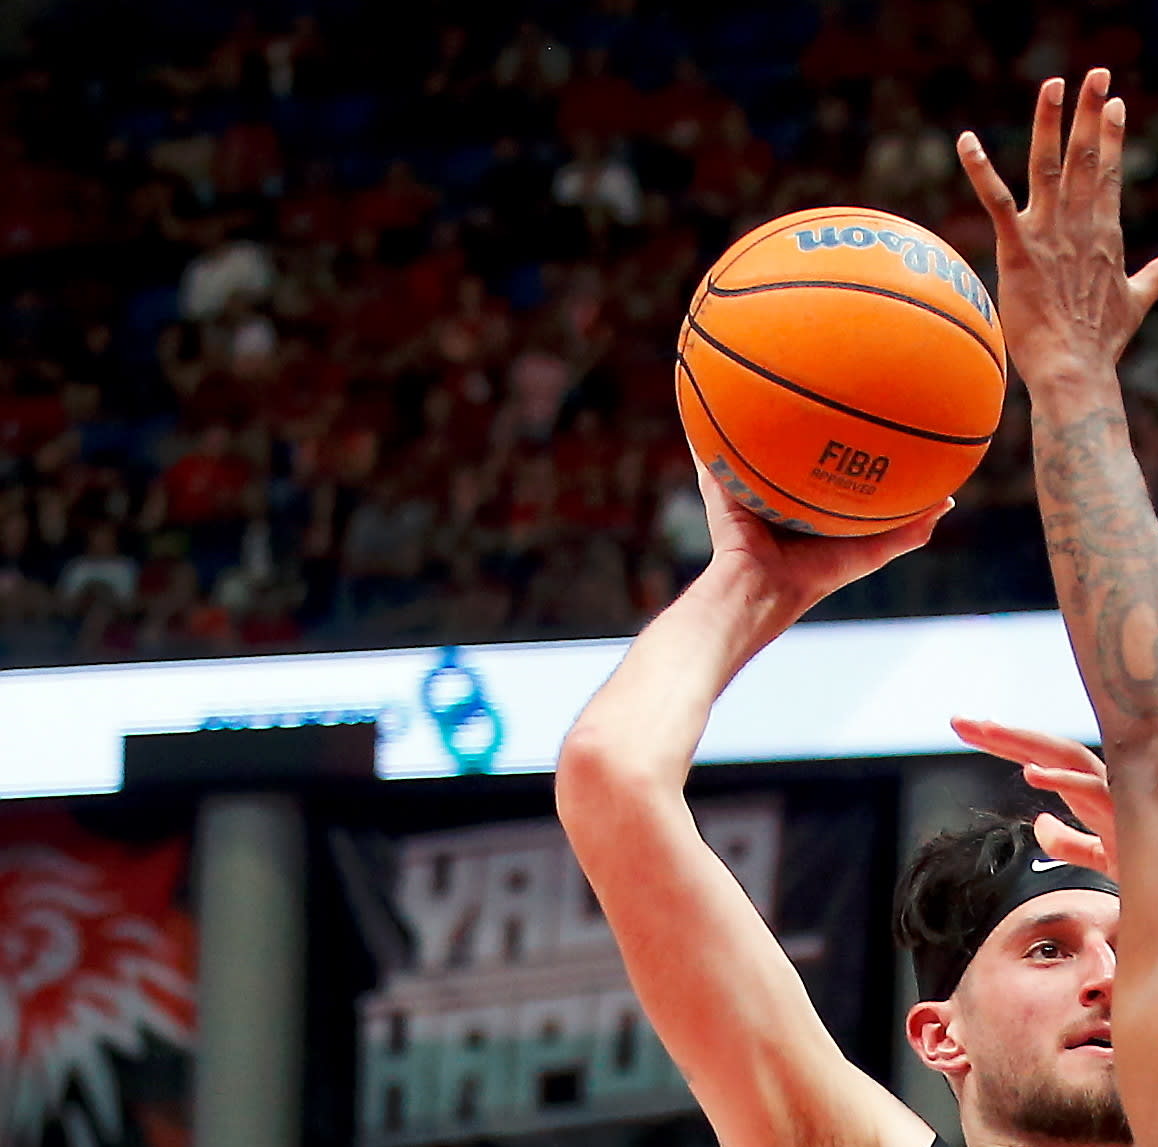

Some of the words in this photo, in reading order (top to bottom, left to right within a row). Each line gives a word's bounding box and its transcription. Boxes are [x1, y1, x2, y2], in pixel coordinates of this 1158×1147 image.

[793, 226, 995, 325] Wilson
[809, 467, 878, 496] APPROVED
[818, 440, 890, 483] FIBA
[398, 797, 782, 968] YALA
